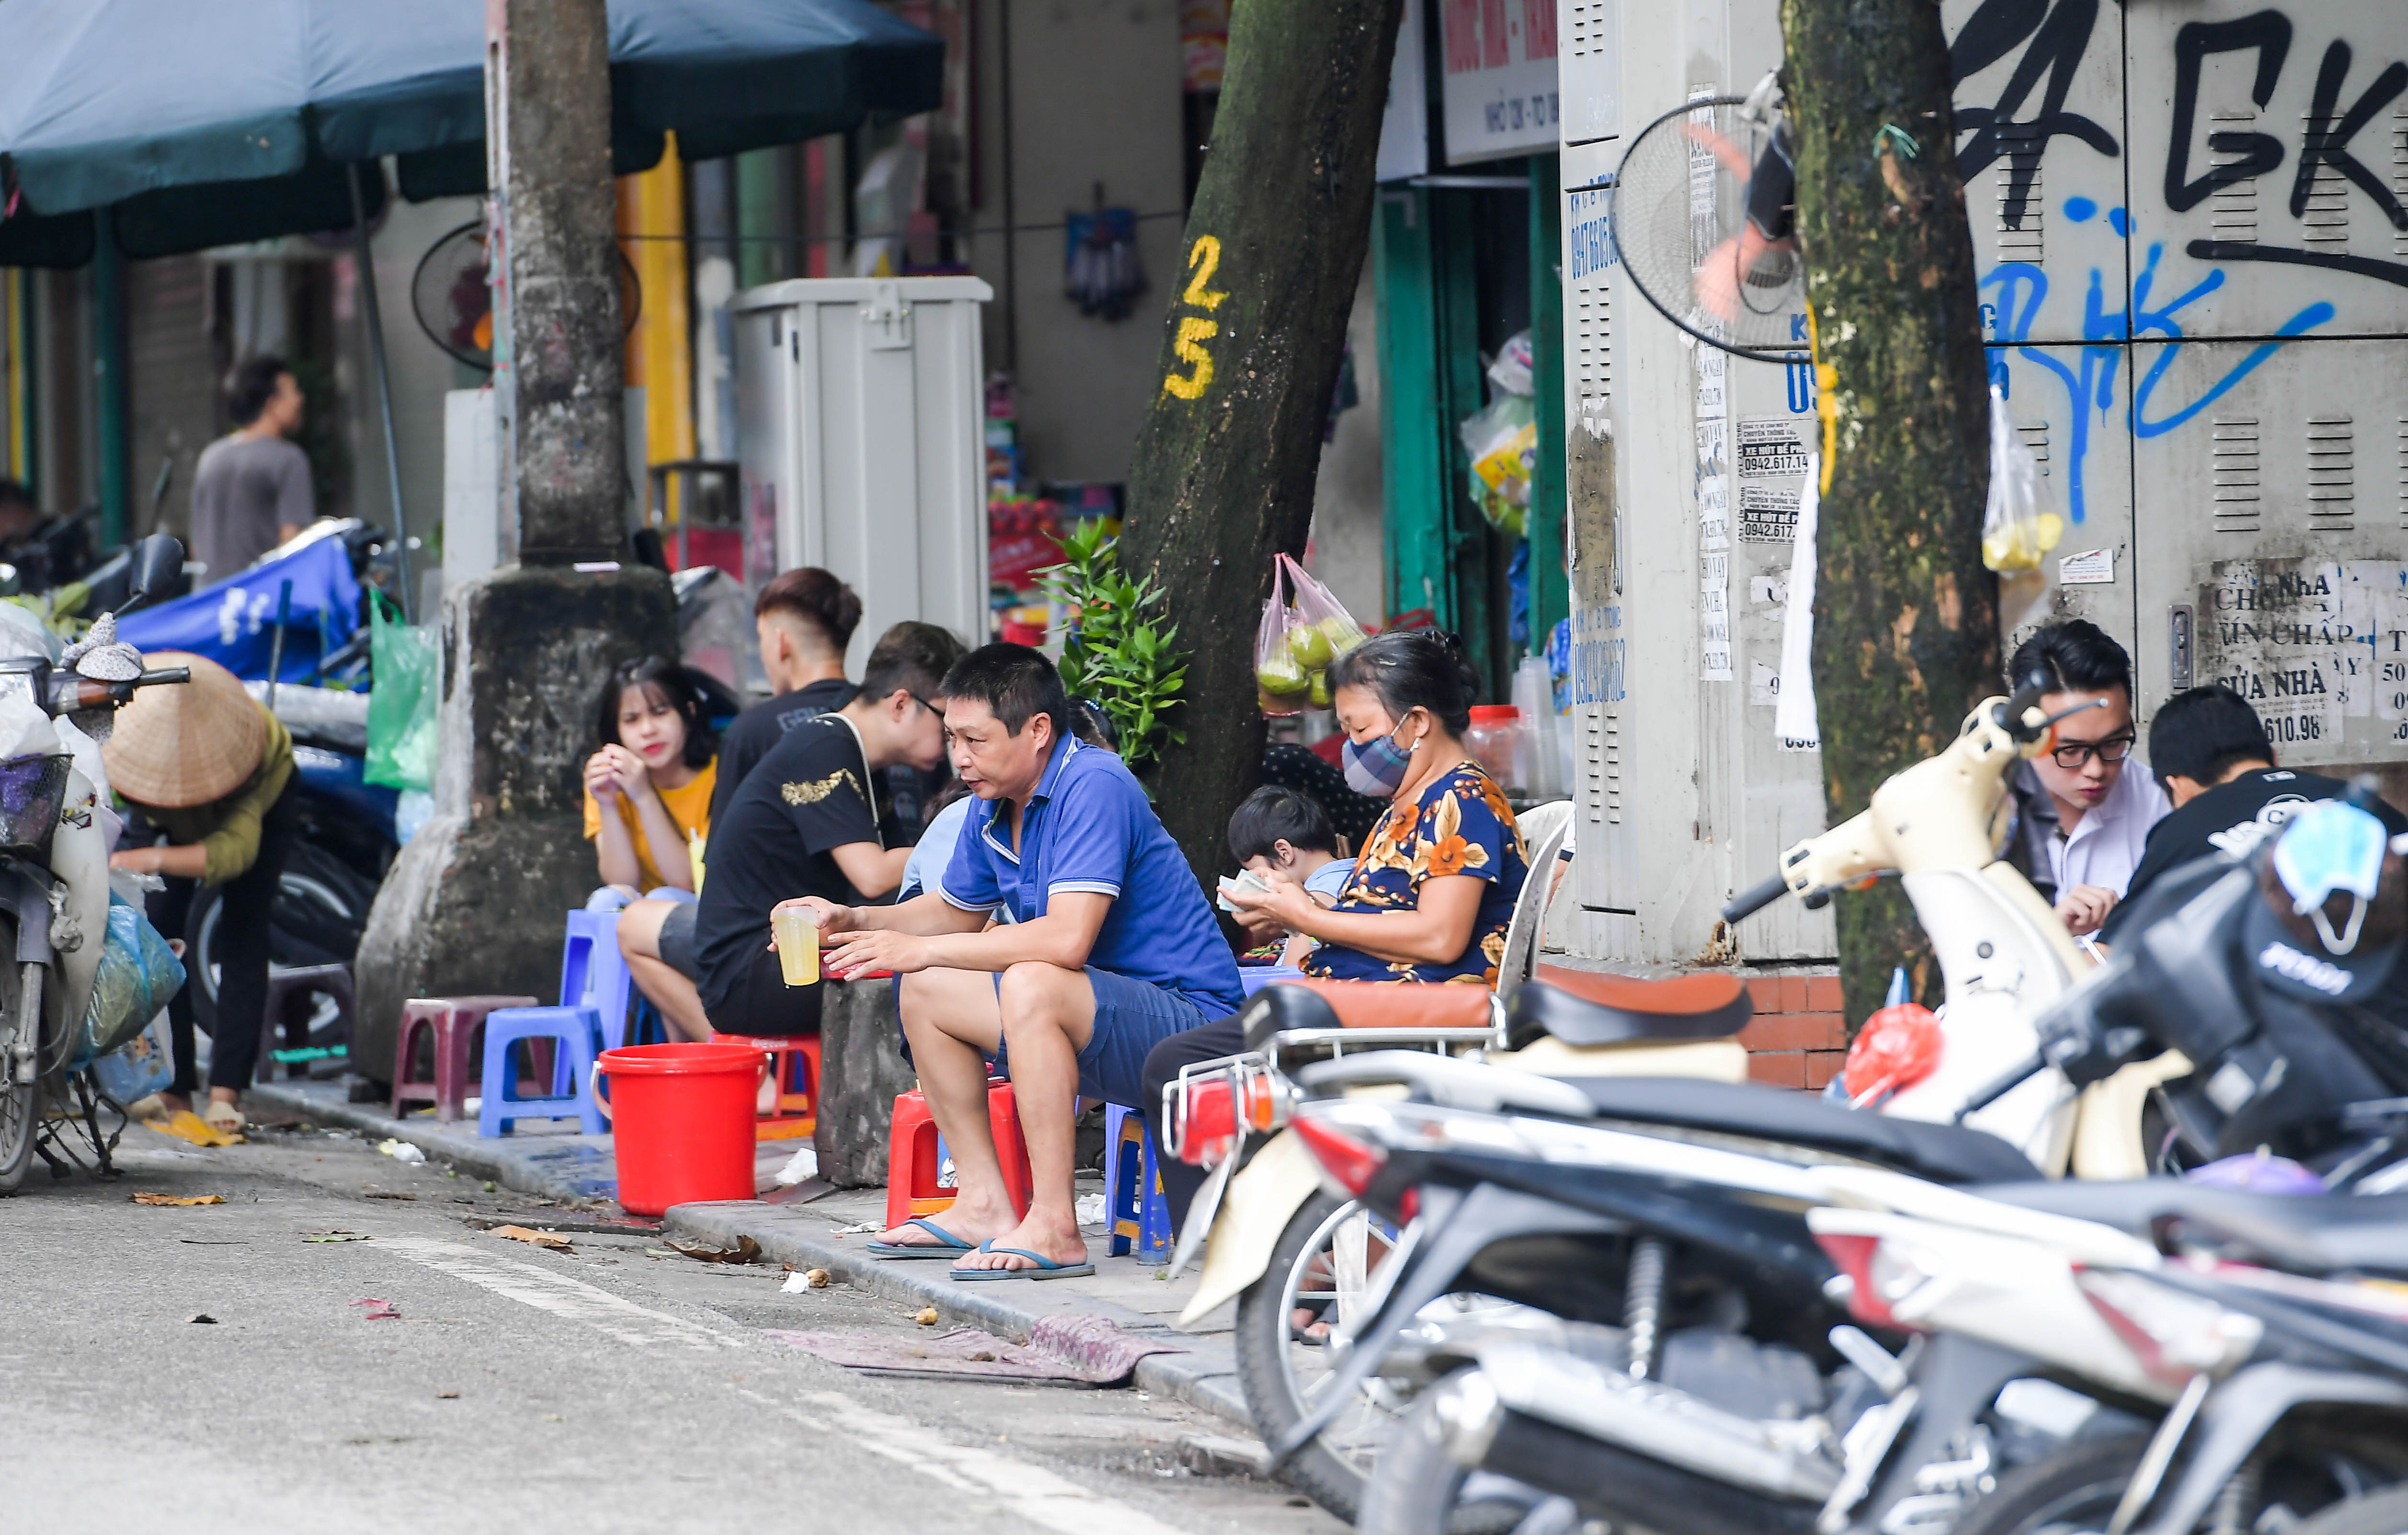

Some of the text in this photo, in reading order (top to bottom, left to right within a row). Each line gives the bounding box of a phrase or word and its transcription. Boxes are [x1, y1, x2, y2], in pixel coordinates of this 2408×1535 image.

[1745, 446, 1757, 456] XE
[1758, 444, 1776, 455] HÚT
[1747, 512, 1759, 521] XE
[1760, 511, 1778, 522] HÚT
[2271, 661, 2327, 697] NHÀ
